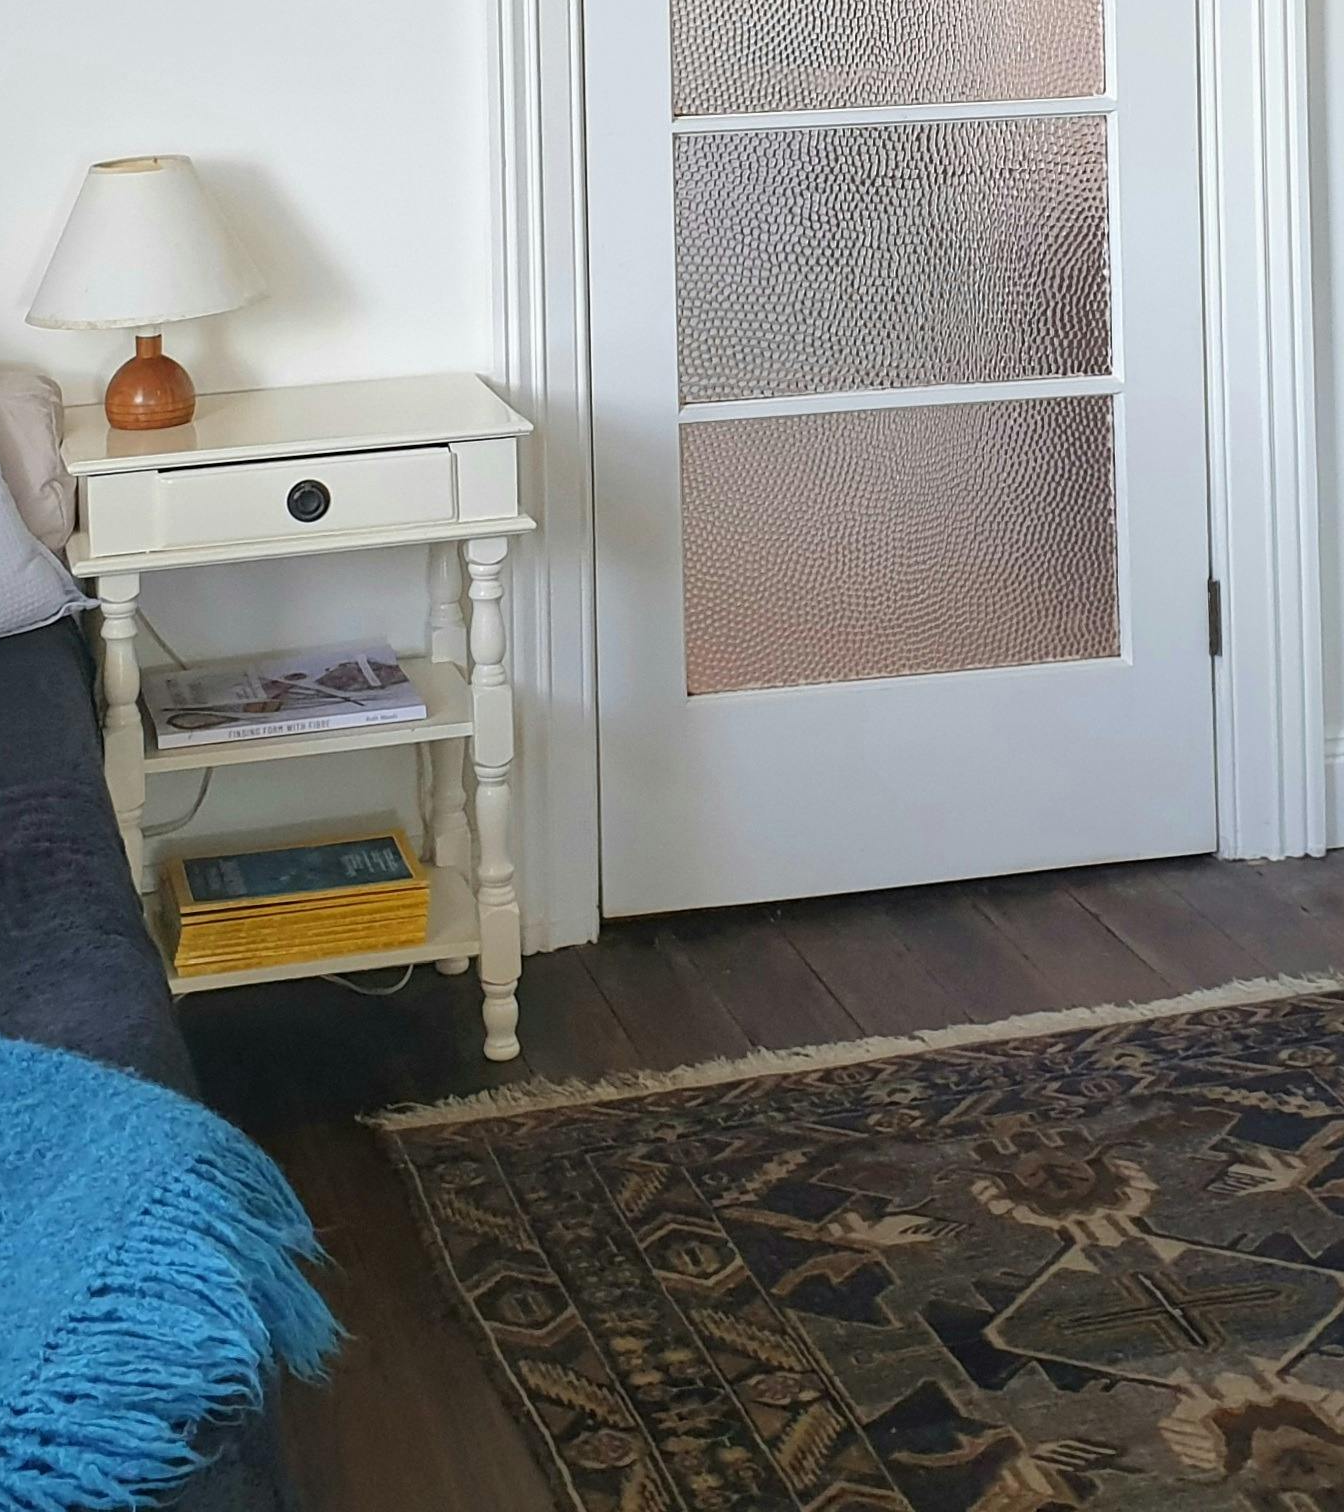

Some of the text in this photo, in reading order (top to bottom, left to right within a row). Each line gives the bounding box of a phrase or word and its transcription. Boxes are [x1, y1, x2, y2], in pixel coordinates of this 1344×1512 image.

[228, 718, 331, 739] FINDING FORM WITH FIBRE
